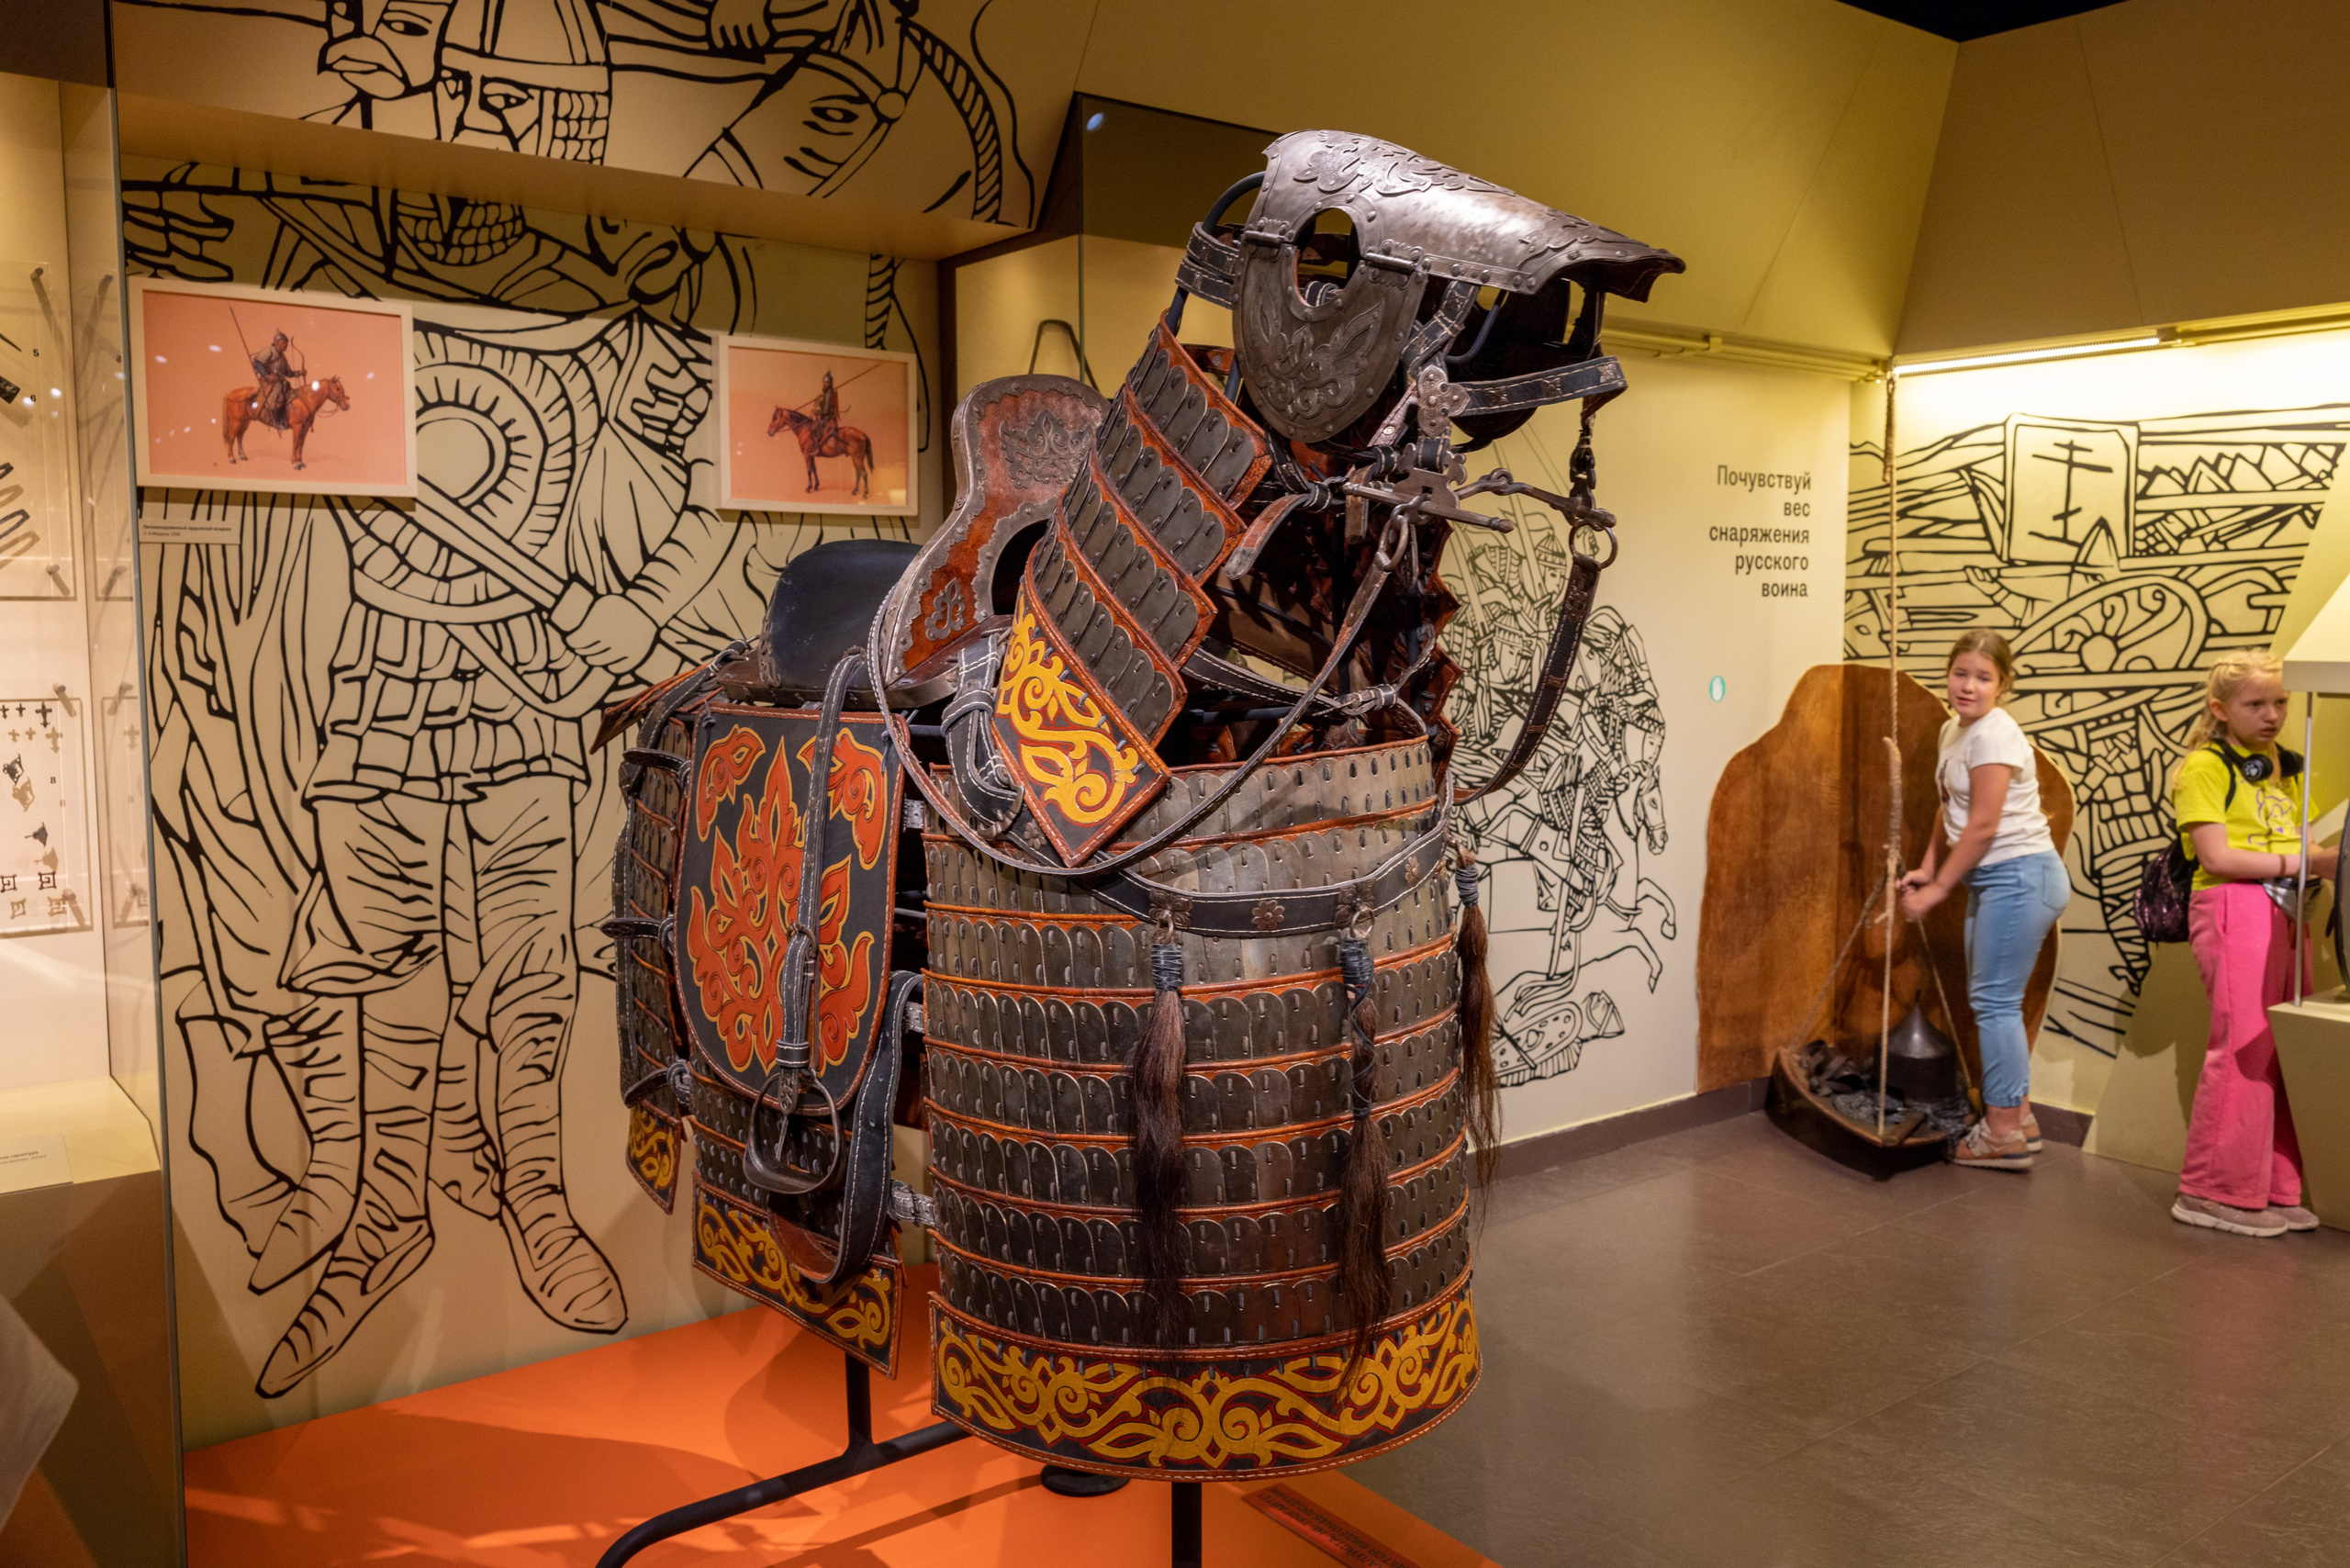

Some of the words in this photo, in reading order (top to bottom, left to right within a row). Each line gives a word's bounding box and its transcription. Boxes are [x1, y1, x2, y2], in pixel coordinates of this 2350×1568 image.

[33, 349, 39, 357] 5
[1717, 465, 1811, 495] Почувствуй
[1784, 502, 1811, 517] вес
[1709, 526, 1810, 547] снаряжения
[1735, 554, 1809, 576] русского
[1762, 582, 1808, 597] воина
